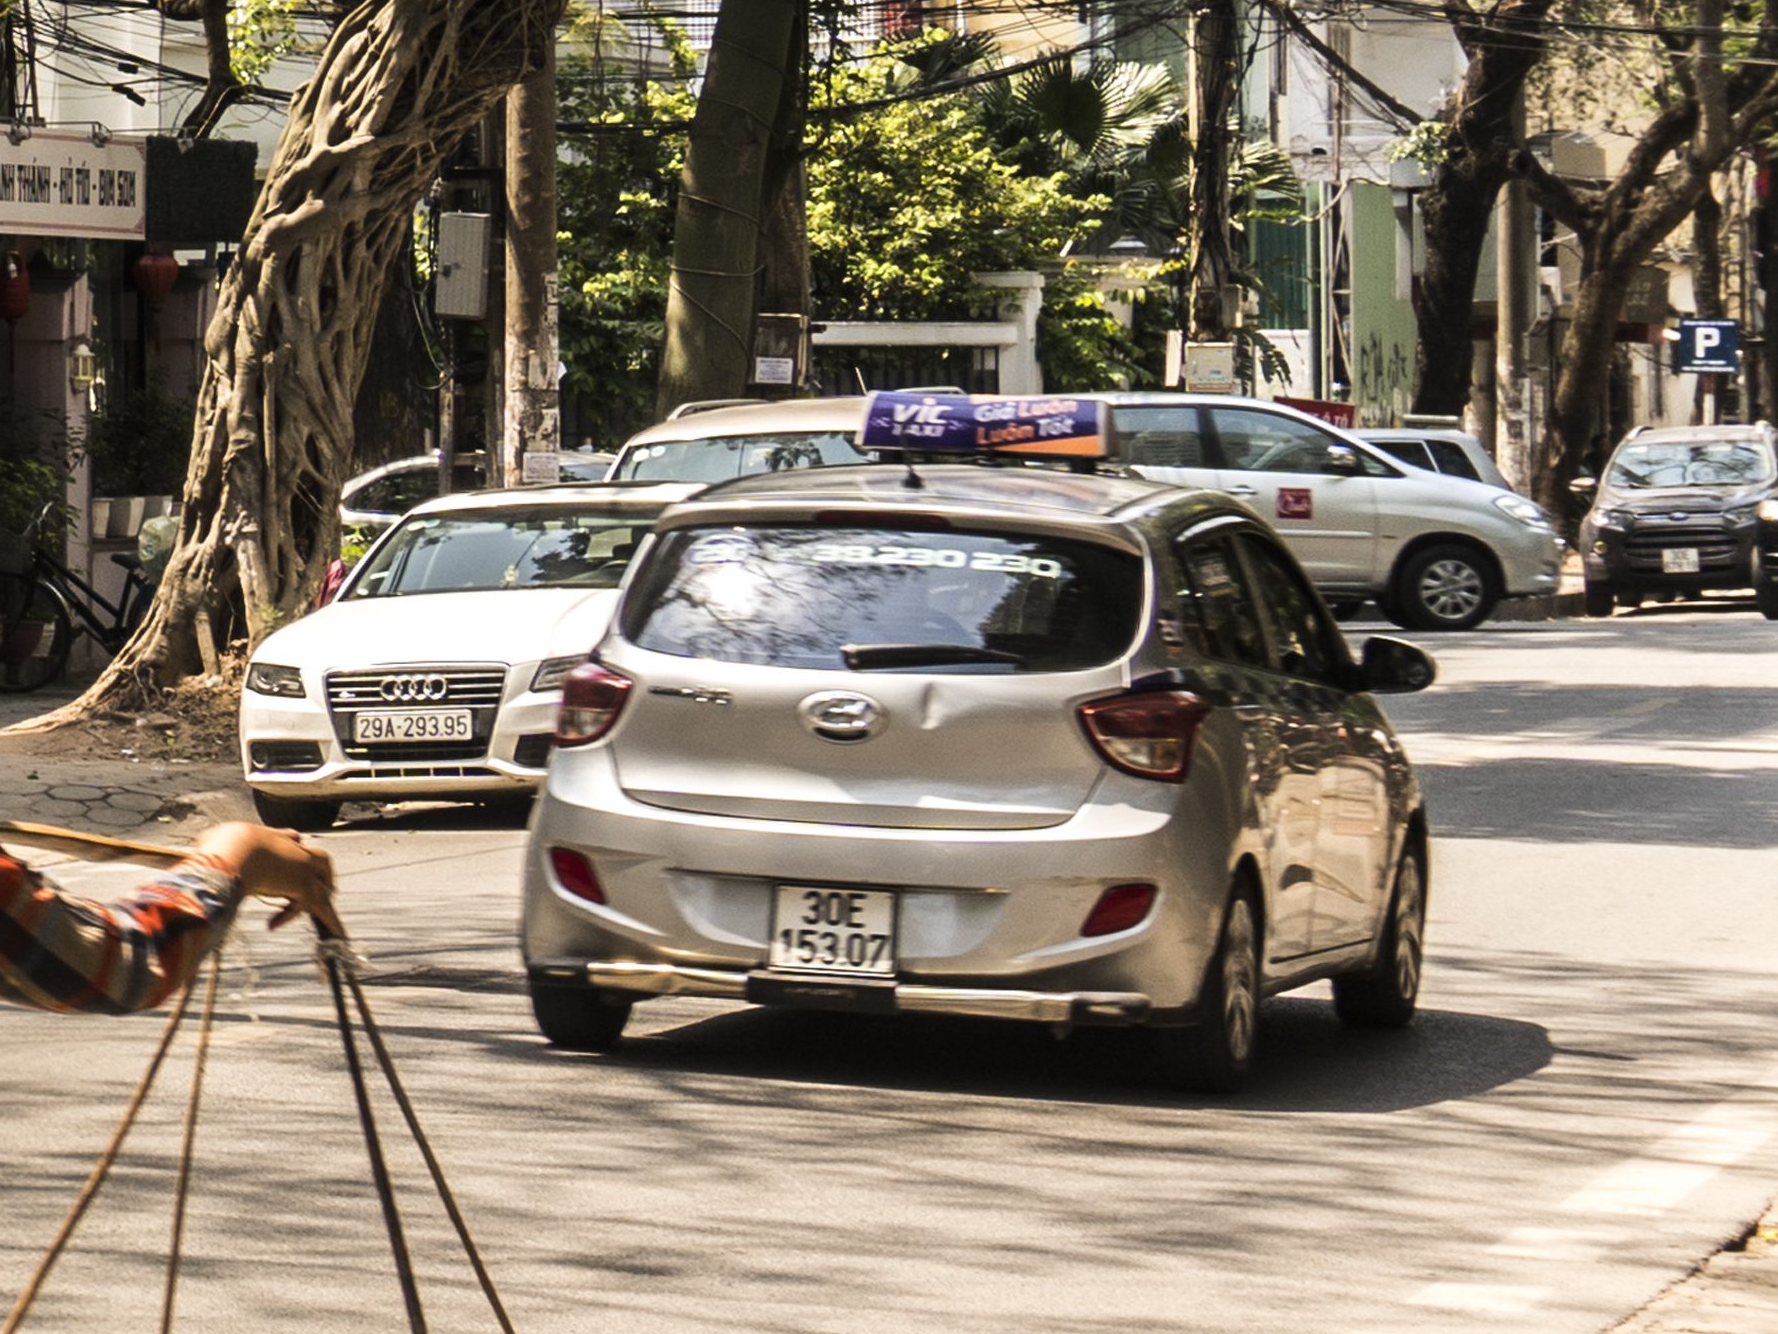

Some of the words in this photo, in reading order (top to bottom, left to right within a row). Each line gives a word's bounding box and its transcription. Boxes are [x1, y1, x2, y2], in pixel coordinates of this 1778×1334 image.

[1696, 327, 1720, 358] P
[360, 715, 467, 739] 29A-293.95
[801, 890, 867, 928] 30E
